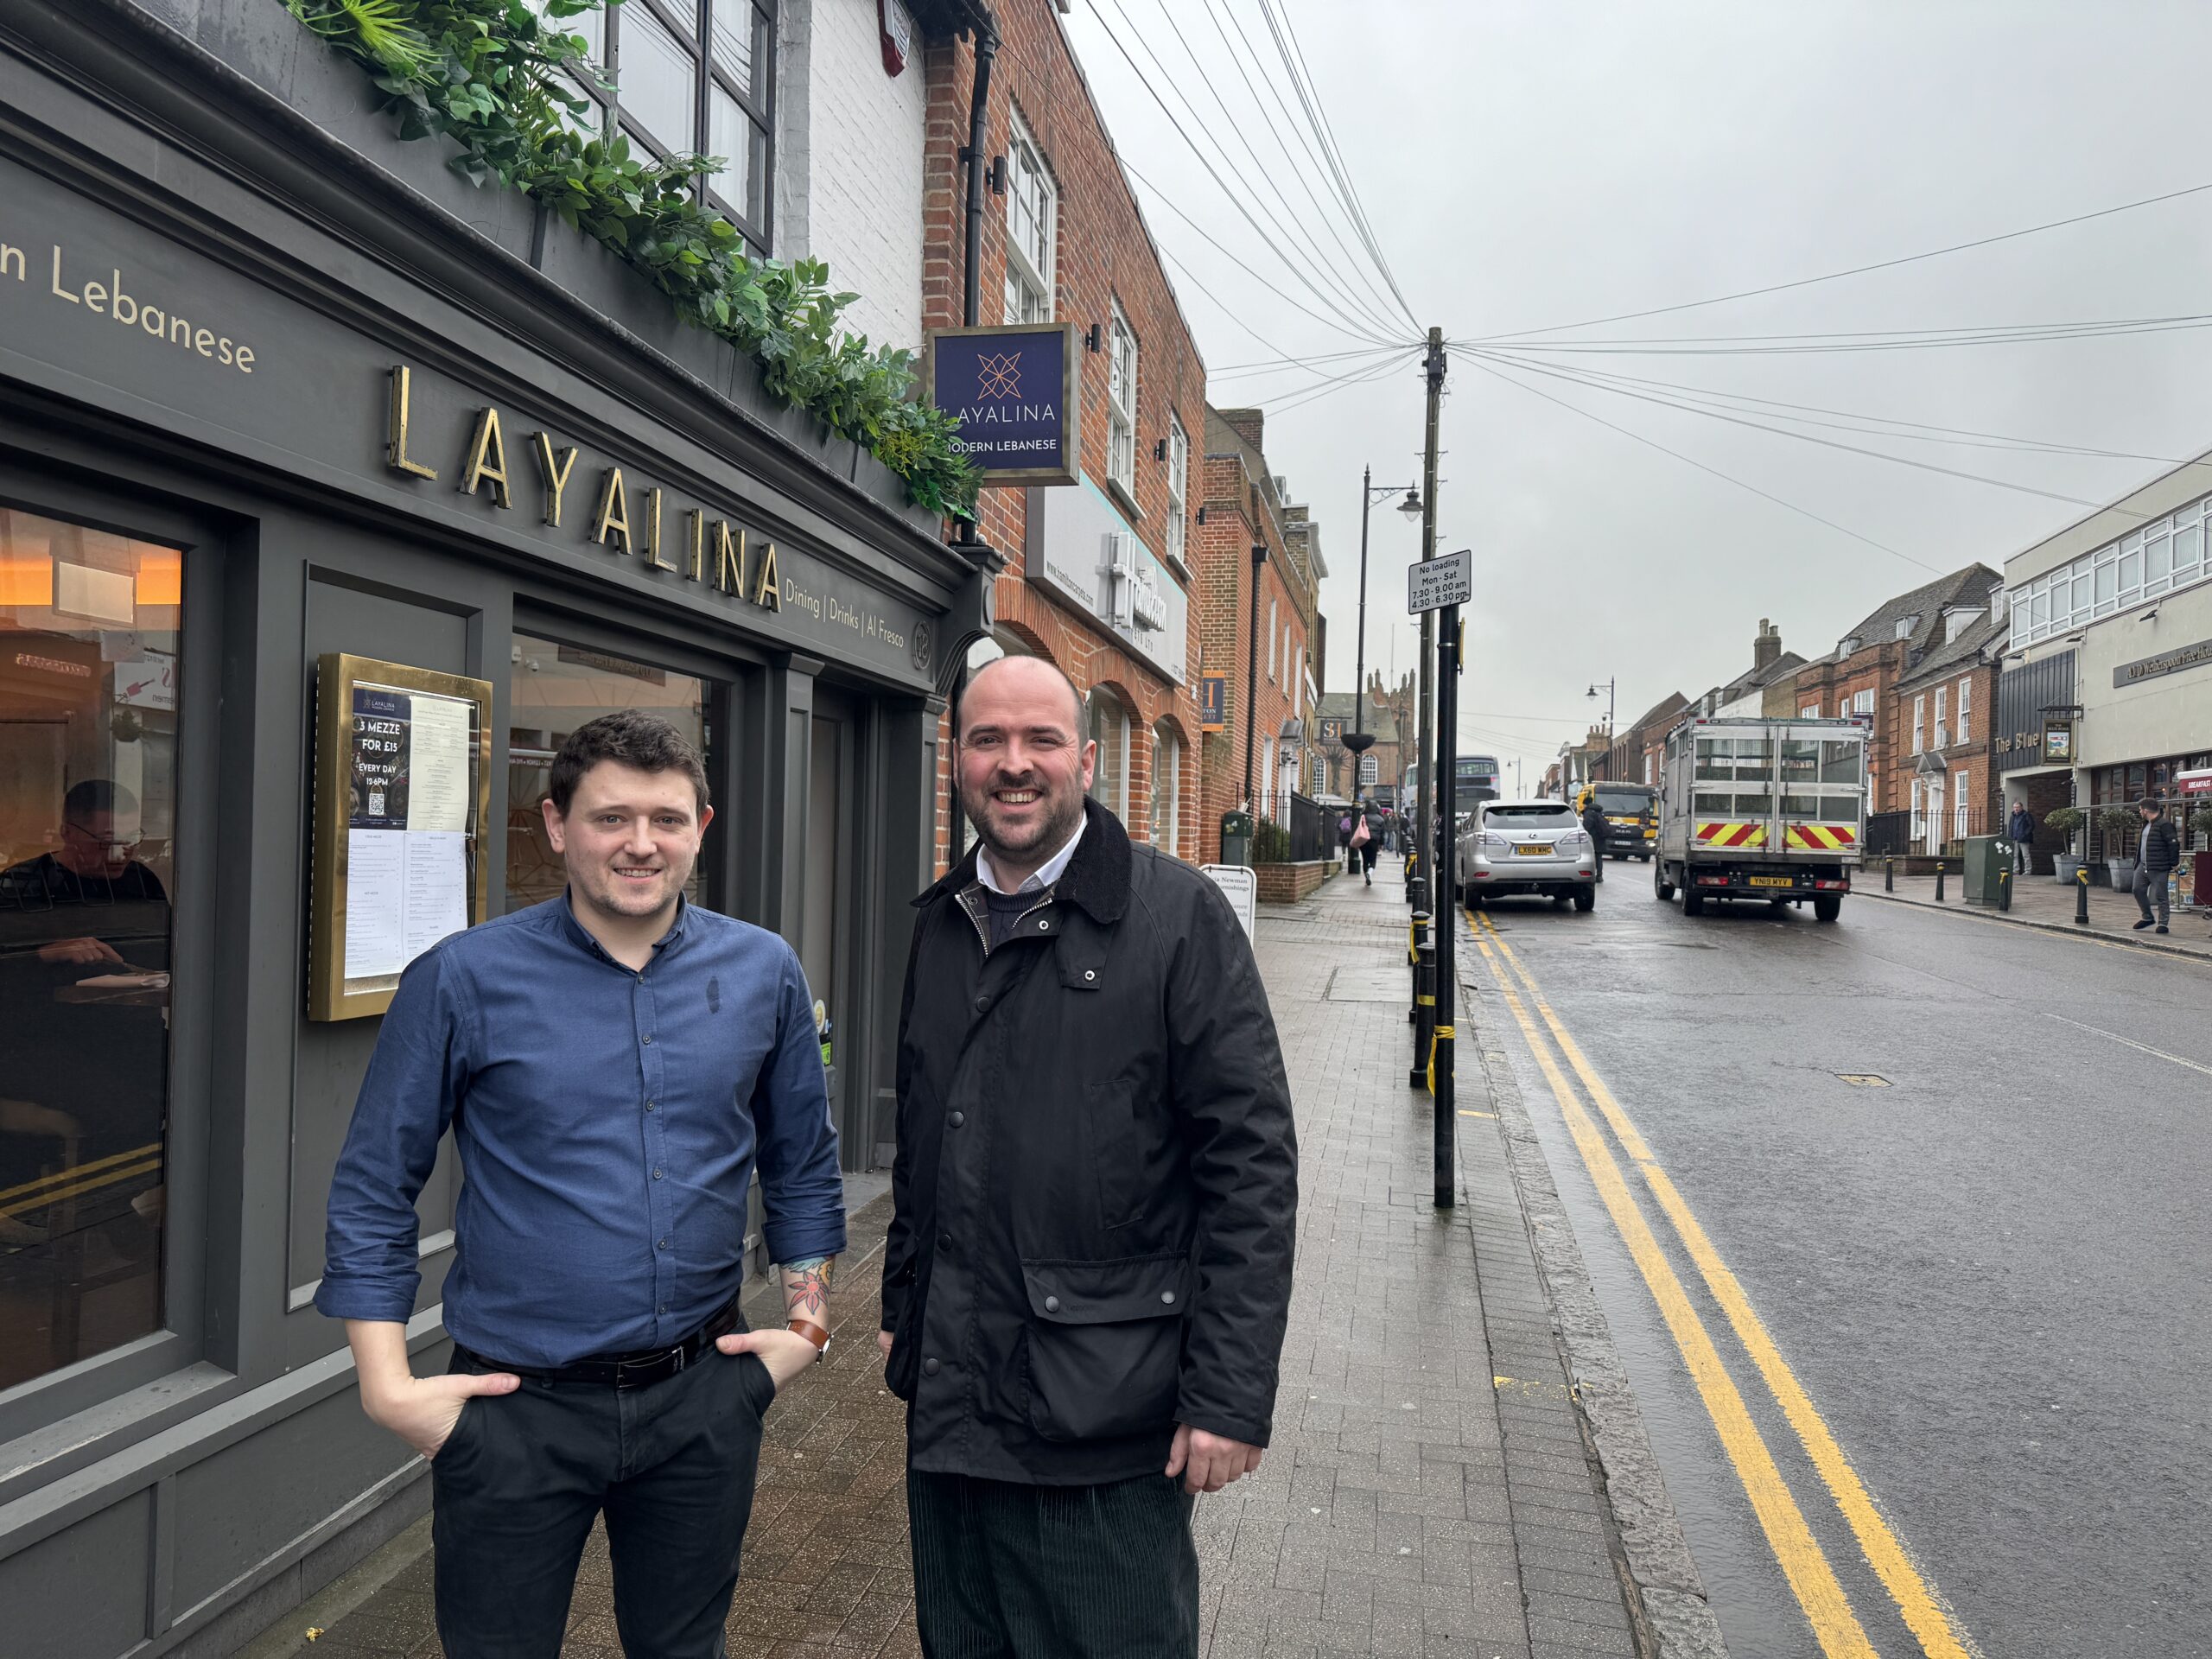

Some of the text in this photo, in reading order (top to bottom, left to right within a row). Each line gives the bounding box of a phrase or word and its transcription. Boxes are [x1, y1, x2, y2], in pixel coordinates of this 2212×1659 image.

[52, 245, 256, 373] Lebanese
[944, 403, 1056, 424] AYALINA
[996, 439, 1057, 452] LEBANESE
[388, 365, 782, 613] LAYALINA
[1432, 559, 1460, 571] loading
[1421, 577, 1438, 586] Mon
[1443, 570, 1458, 581] Sat
[1411, 598, 1430, 608] 4.30
[1435, 592, 1454, 603] 6.30
[1455, 590, 1467, 601] pm
[1412, 588, 1430, 600] 7.30
[1434, 582, 1453, 594] 9.00
[1454, 581, 1467, 589] am
[785, 577, 820, 619] Dining
[830, 597, 859, 630] Drinks
[867, 614, 876, 637] Al
[878, 619, 905, 648] Fresco
[359, 720, 401, 734] 3 MEZZE
[362, 739, 397, 753] FOR £15
[1994, 732, 2040, 753] The Blue
[358, 763, 397, 774] EVERY DAY
[2188, 779, 2211, 789] BREAKFAST
